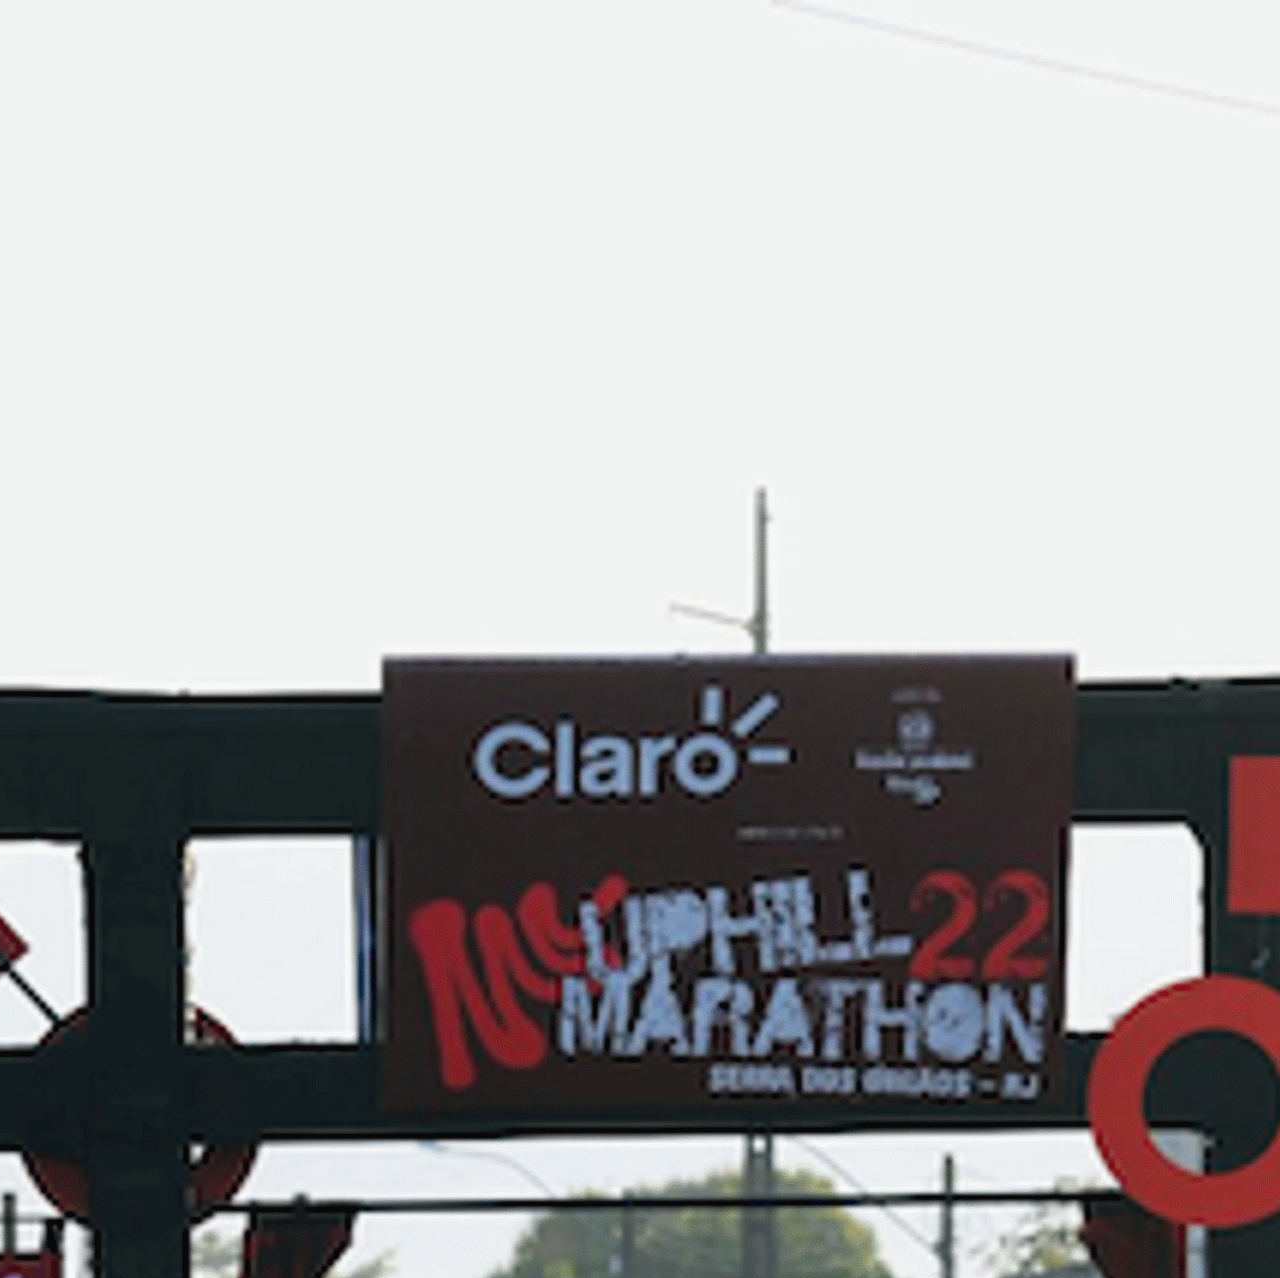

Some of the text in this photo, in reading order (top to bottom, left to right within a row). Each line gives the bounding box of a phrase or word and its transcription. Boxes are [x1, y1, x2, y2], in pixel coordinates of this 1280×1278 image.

[473, 718, 740, 798] Claro
[581, 866, 913, 990] UPHILL
[910, 868, 1050, 980] 22
[558, 954, 1048, 1064] MARATHON
